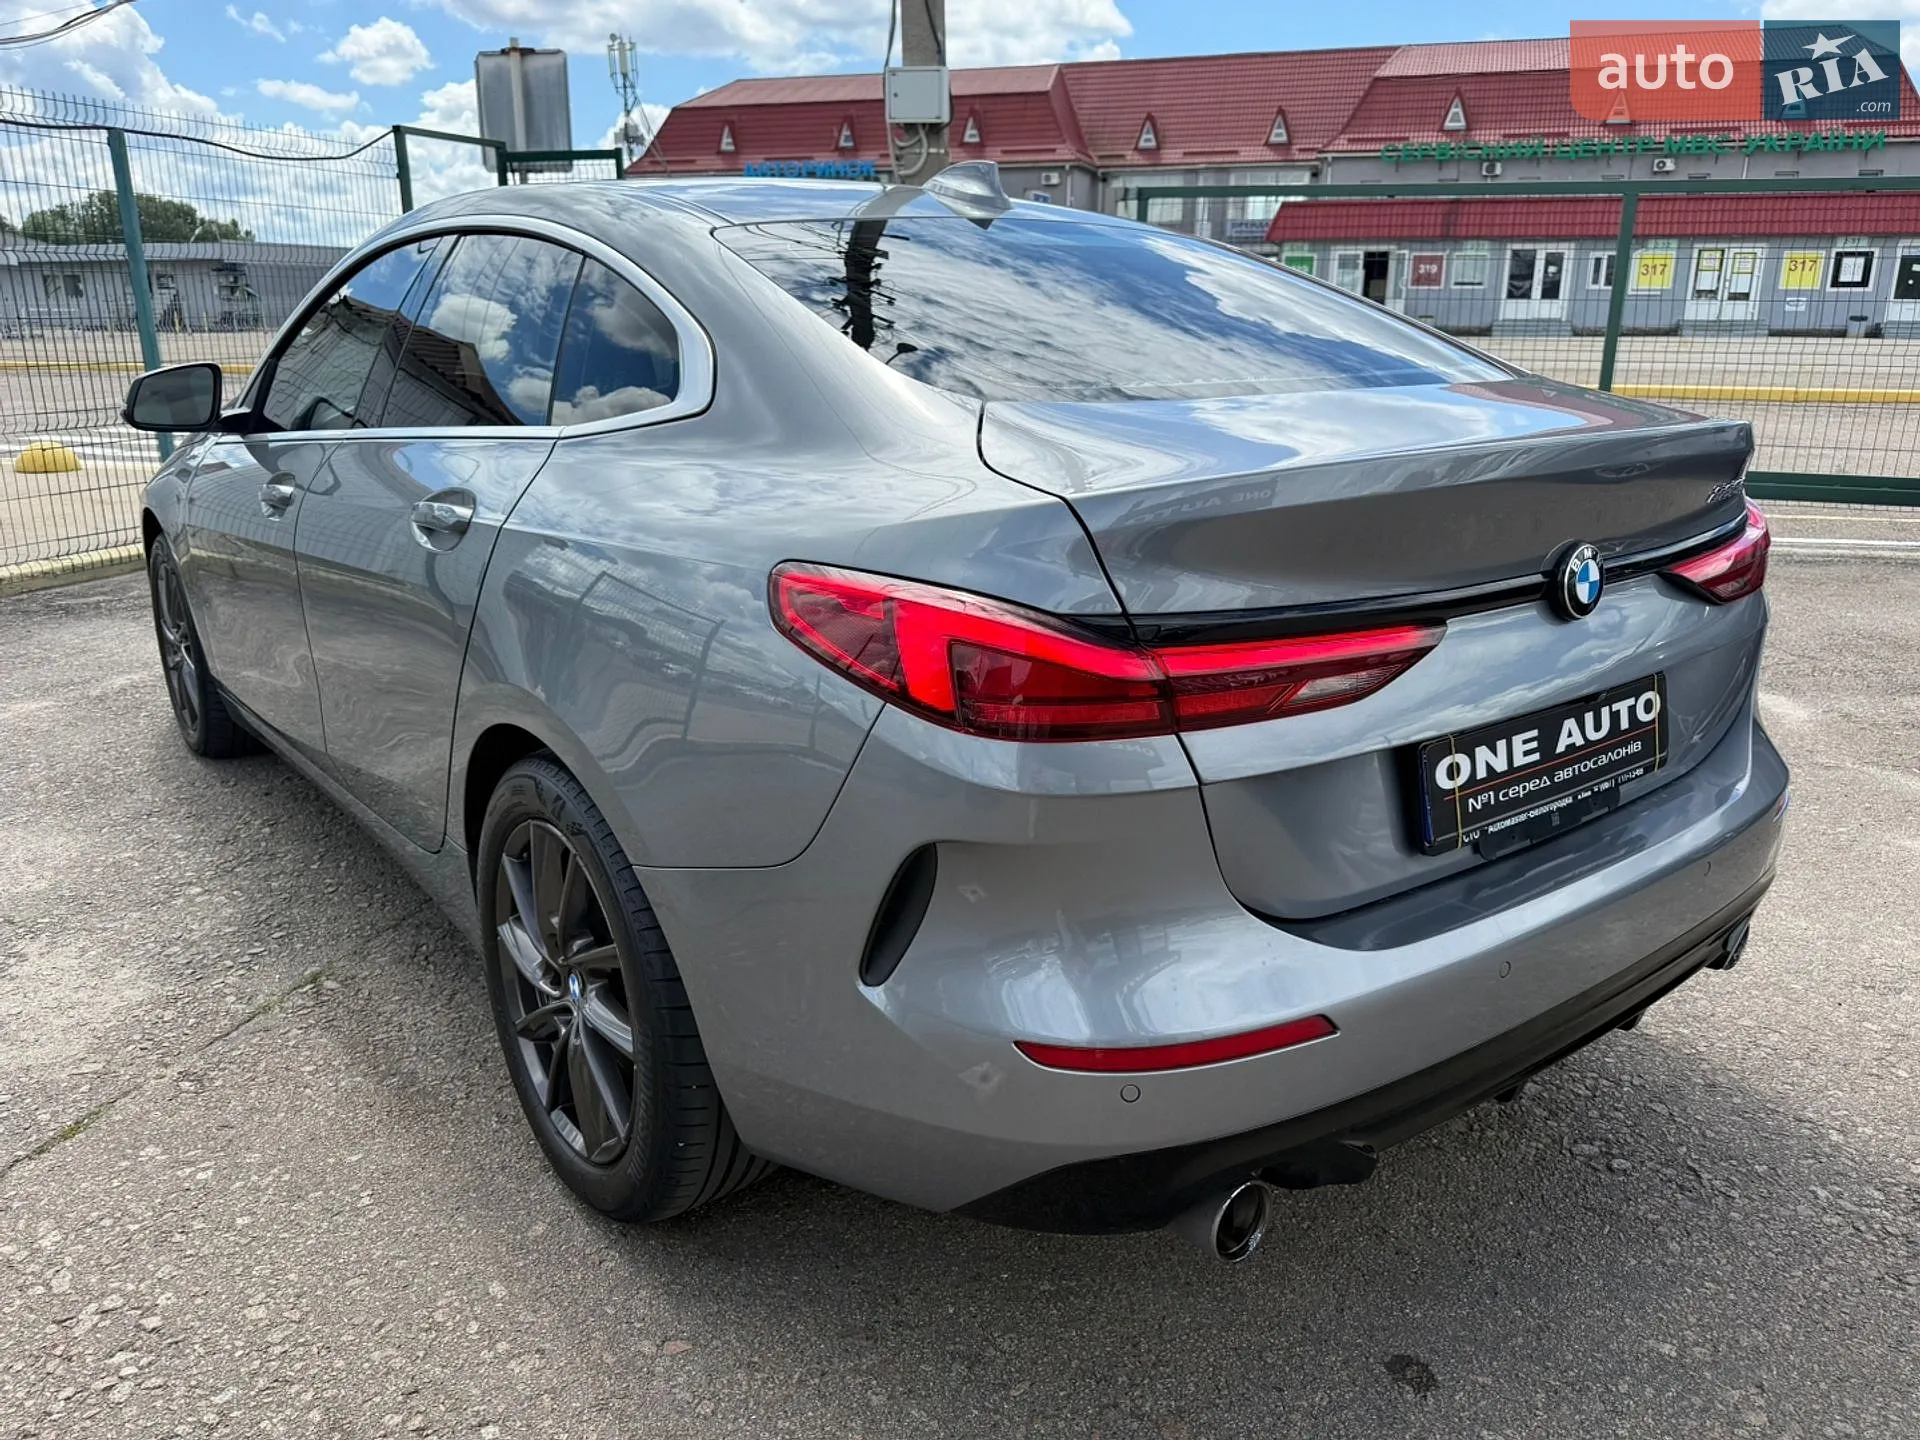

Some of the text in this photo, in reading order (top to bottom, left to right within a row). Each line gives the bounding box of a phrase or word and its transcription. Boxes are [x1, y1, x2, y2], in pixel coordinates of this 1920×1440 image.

[1556, 135, 1653, 160] ЦЕНТР
[1664, 134, 1733, 154] МВС
[1745, 127, 1886, 154] УКРАЇНИ
[1641, 263, 1667, 277] 317
[1788, 259, 1817, 272] 317
[1435, 729, 1541, 790] ONE
[1555, 691, 1661, 754] AUTO
[1499, 776, 1550, 798] серед
[1554, 740, 1642, 783] автосалонів
